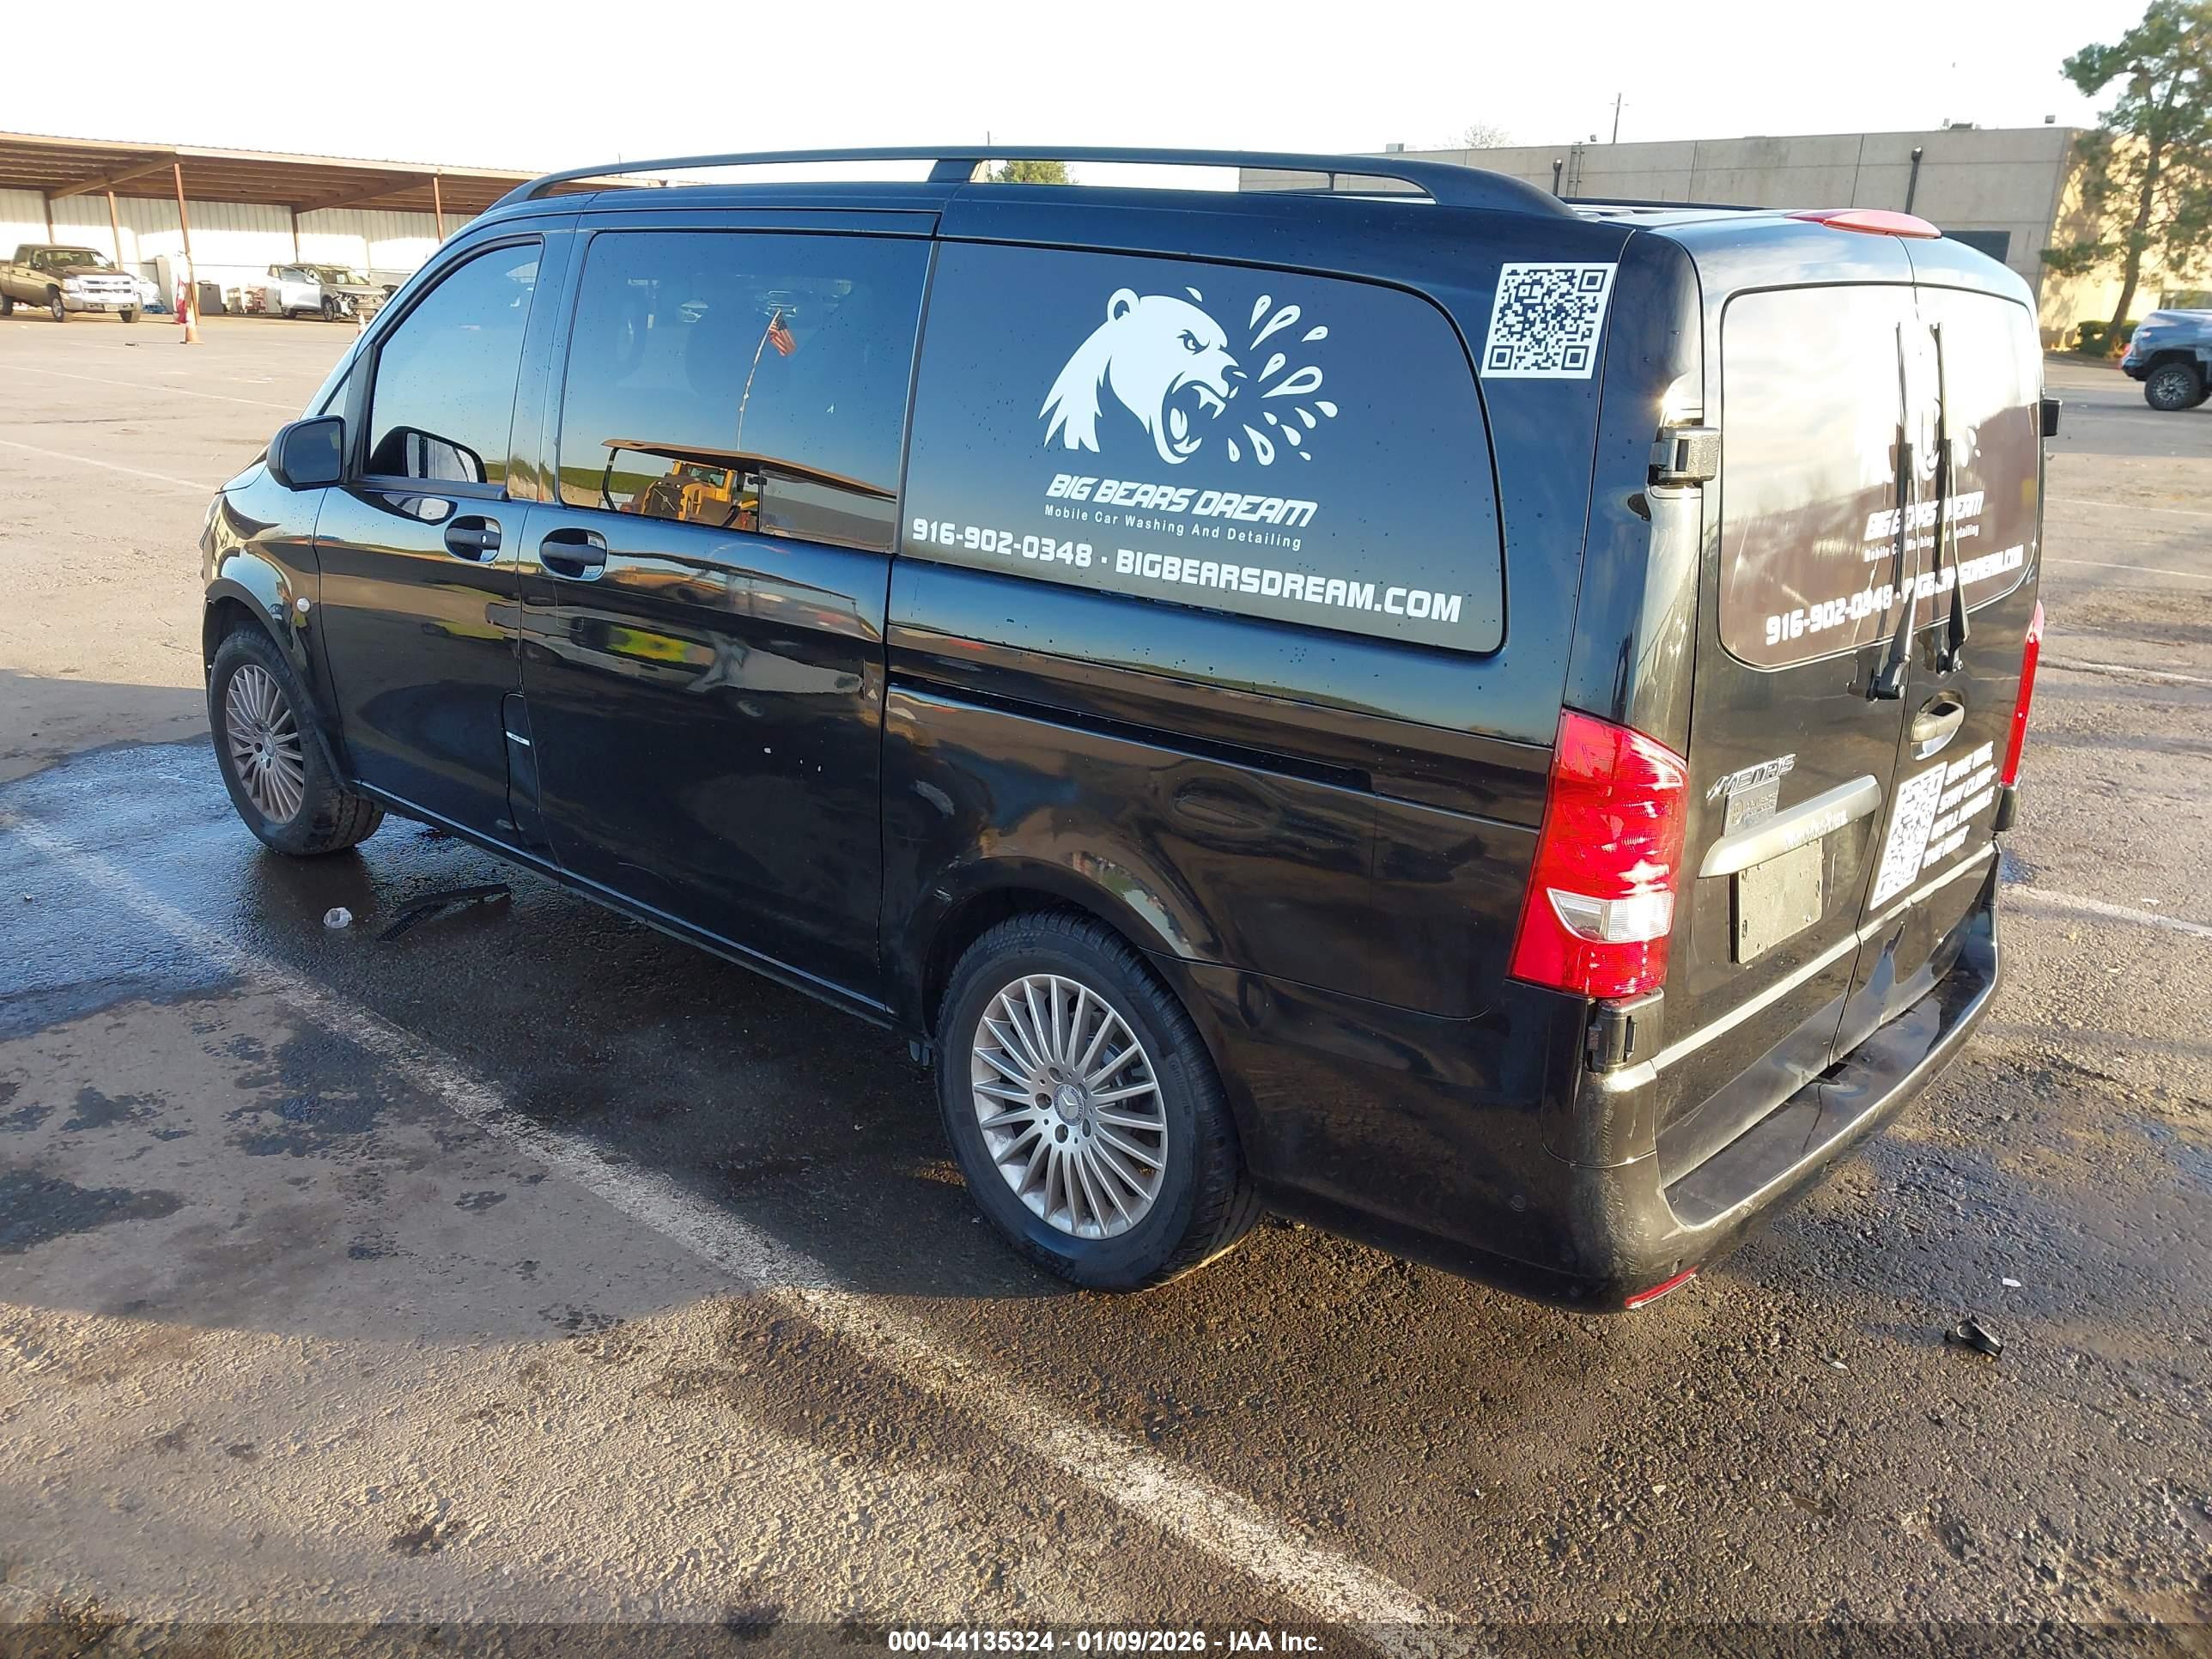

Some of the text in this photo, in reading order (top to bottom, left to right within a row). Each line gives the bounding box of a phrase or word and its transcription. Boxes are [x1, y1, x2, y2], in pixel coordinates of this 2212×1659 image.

[1045, 473, 1318, 527] BIG BEARS DREAM
[1045, 504, 1301, 551] Mobile Car Washing And Detailing
[913, 519, 1093, 568] 916-902-0348
[1116, 549, 1462, 623] BIGBEARSDREAM.COM
[1765, 584, 1893, 646] 916-902-0348
